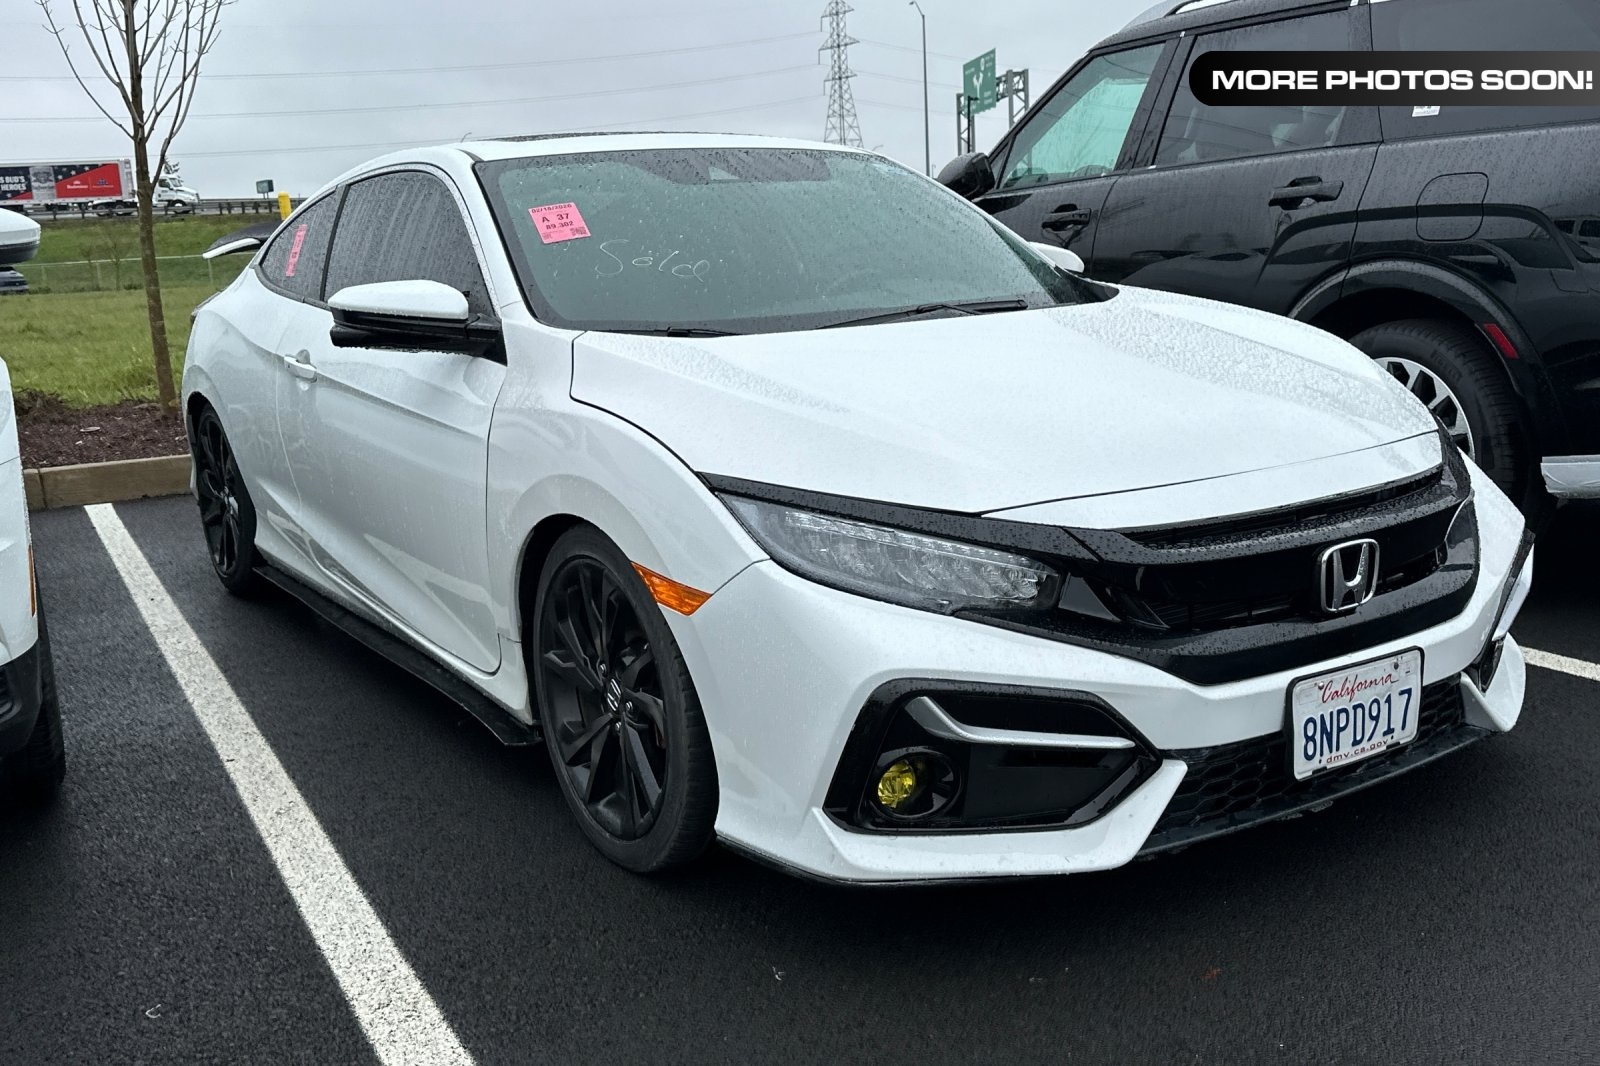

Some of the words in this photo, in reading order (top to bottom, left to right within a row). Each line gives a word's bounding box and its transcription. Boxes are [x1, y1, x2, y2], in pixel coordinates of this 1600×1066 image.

[556, 212, 569, 221] 37
[1321, 673, 1399, 704] California
[1303, 687, 1413, 761] 8NPD917
[1326, 739, 1389, 764] dmv.ca.gov
